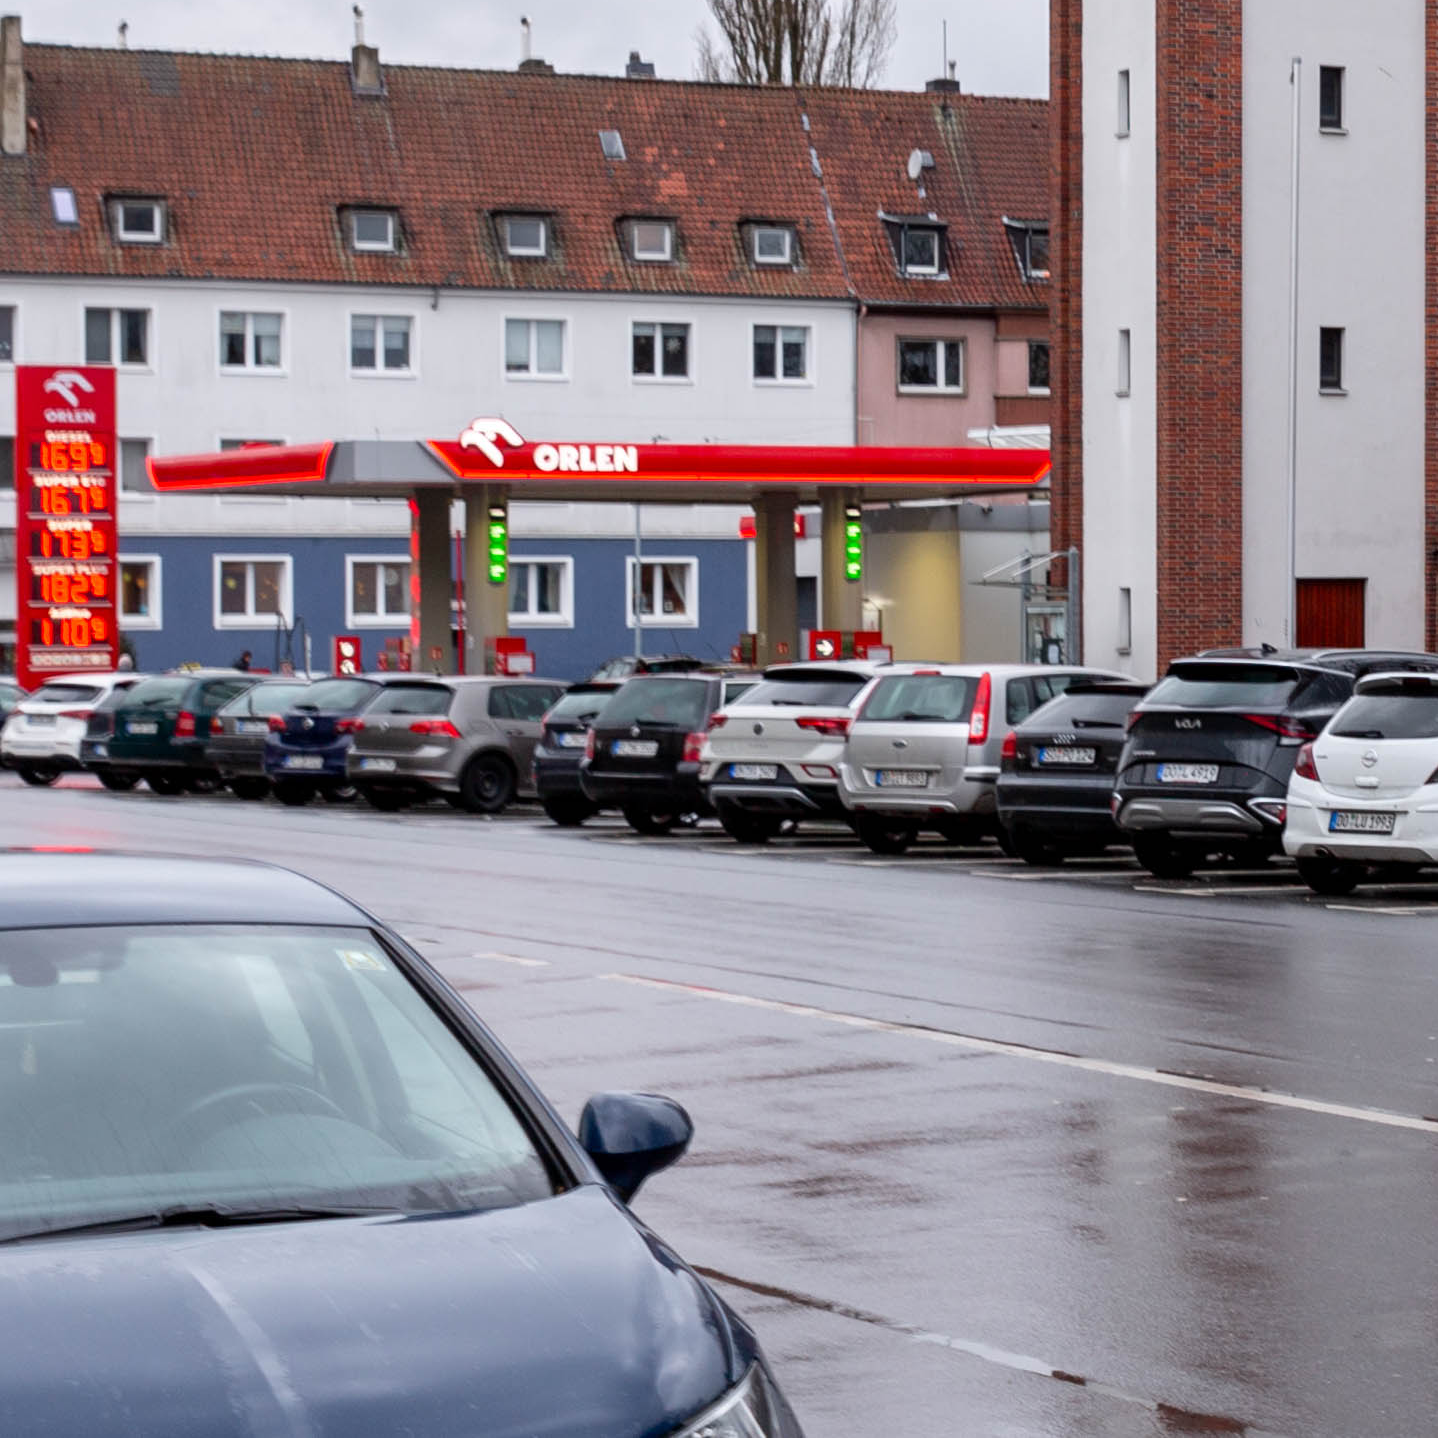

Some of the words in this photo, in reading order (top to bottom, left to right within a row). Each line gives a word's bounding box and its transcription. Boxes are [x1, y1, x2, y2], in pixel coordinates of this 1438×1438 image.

[44, 409, 95, 423] ORLEN
[533, 444, 638, 472] ORLEN
[1337, 814, 1349, 827] DO
[1369, 815, 1393, 829] 1993
